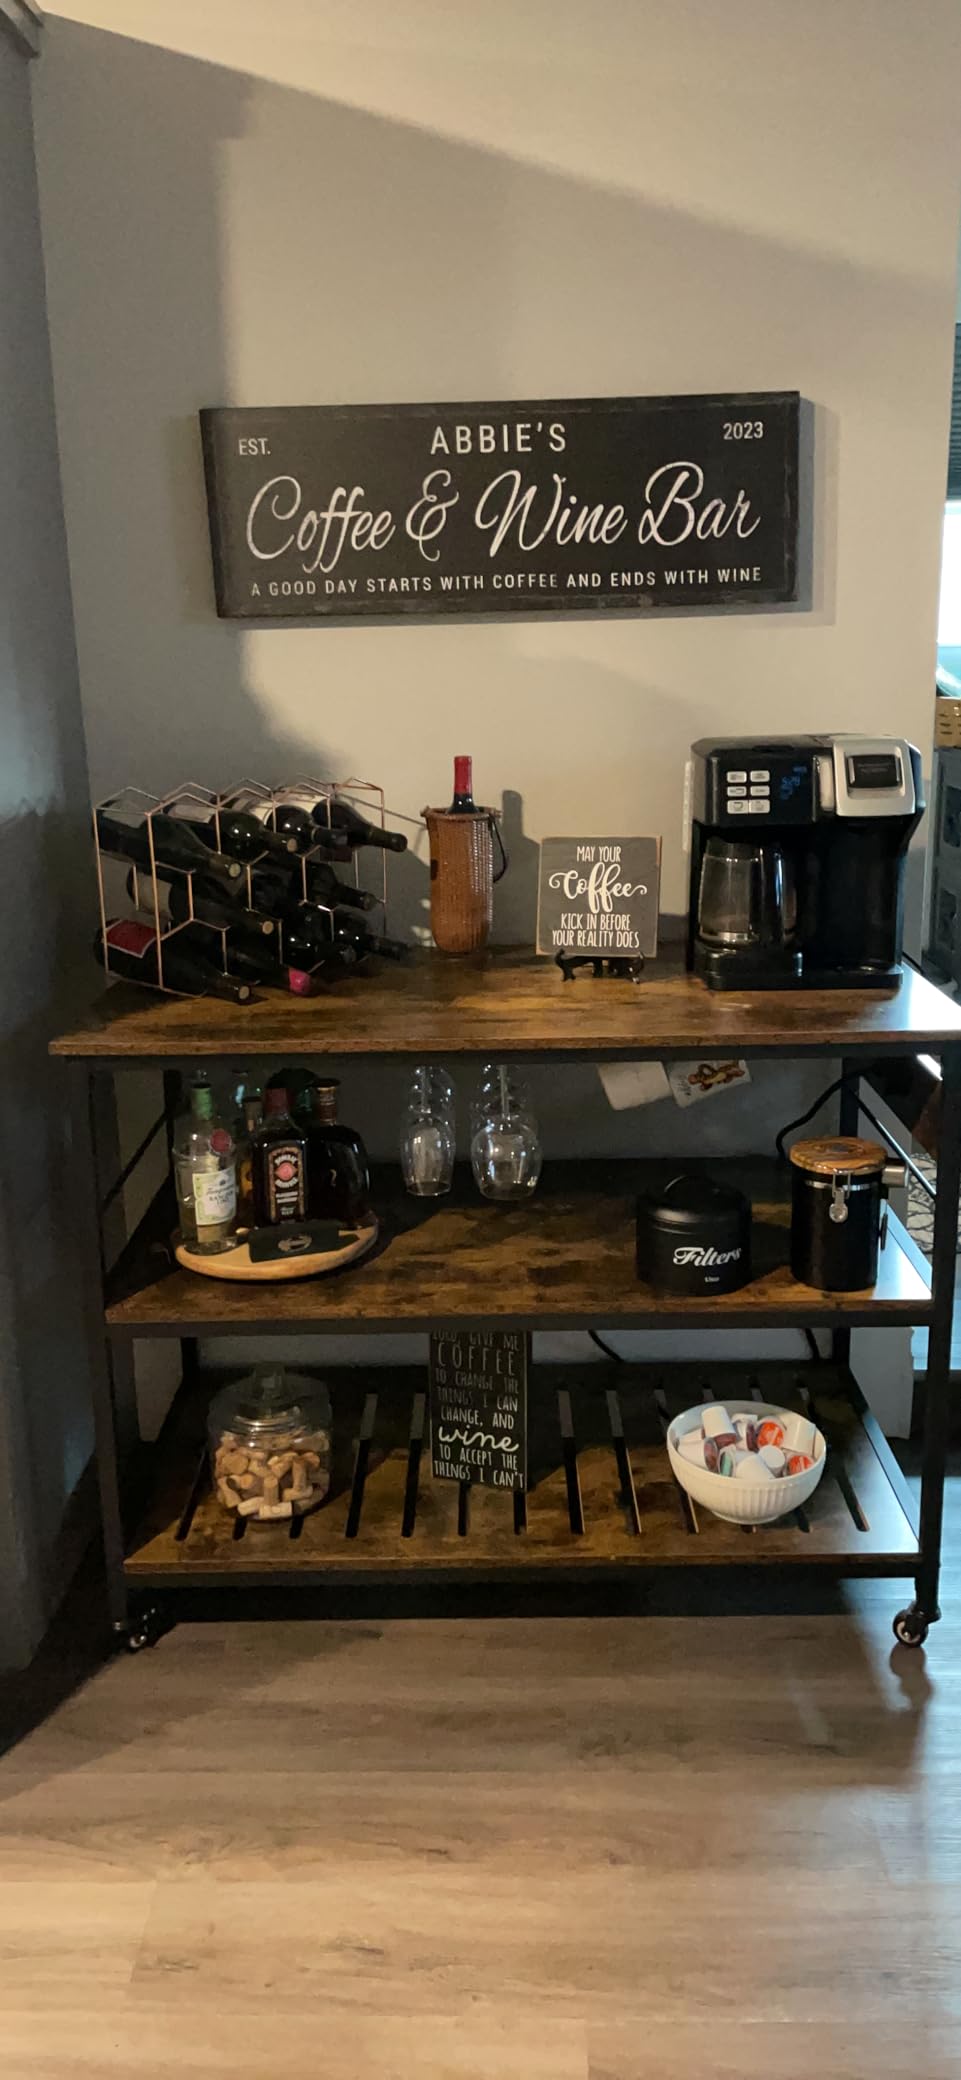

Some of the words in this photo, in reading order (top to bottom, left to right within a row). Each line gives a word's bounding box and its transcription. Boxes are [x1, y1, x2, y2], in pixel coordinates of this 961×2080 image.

[430, 422, 566, 455] ABBIE'S
[723, 421, 764, 440] 2023
[238, 438, 272, 456] EST.
[246, 475, 396, 574] Coffee
[405, 469, 459, 562] &
[475, 469, 628, 558] Wine
[638, 461, 761, 546] Bar
[251, 582, 261, 597] A
[268, 580, 317, 596] GOOD
[325, 579, 358, 594] DAY
[366, 576, 432, 592] STARTS
[439, 575, 485, 590] WITH
[492, 572, 558, 589] COFFEE
[566, 572, 602, 588] AND
[610, 570, 656, 586] ENDS
[663, 569, 709, 585] WITH
[717, 566, 762, 583] WINE
[576, 845, 596, 862] MAY
[598, 846, 622, 862] YOUR
[549, 861, 648, 914] Coffee
[560, 912, 583, 930] KICK
[586, 913, 597, 930] IN
[600, 914, 631, 931] BEFORE
[552, 930, 574, 946] YOUR
[577, 931, 614, 947] REALITY
[616, 931, 640, 949] DOES
[672, 1246, 742, 1267] Filters
[503, 1335, 520, 1351] ME
[438, 1342, 515, 1376] COFFEE
[435, 1367, 447, 1385] TO
[455, 1371, 494, 1391] CHANGE
[503, 1376, 519, 1394] THE
[435, 1386, 473, 1406] THINGS
[482, 1393, 489, 1408] I
[497, 1394, 518, 1413] CAN
[440, 1405, 484, 1427] CHANGE,
[492, 1412, 515, 1430] AND
[438, 1424, 519, 1451] wine
[439, 1443, 451, 1460] TO
[459, 1447, 493, 1466] ACCEPT
[502, 1453, 518, 1471] THE
[434, 1460, 471, 1481] THINGS
[479, 1467, 485, 1483] I
[492, 1469, 525, 1489] CAN'T
